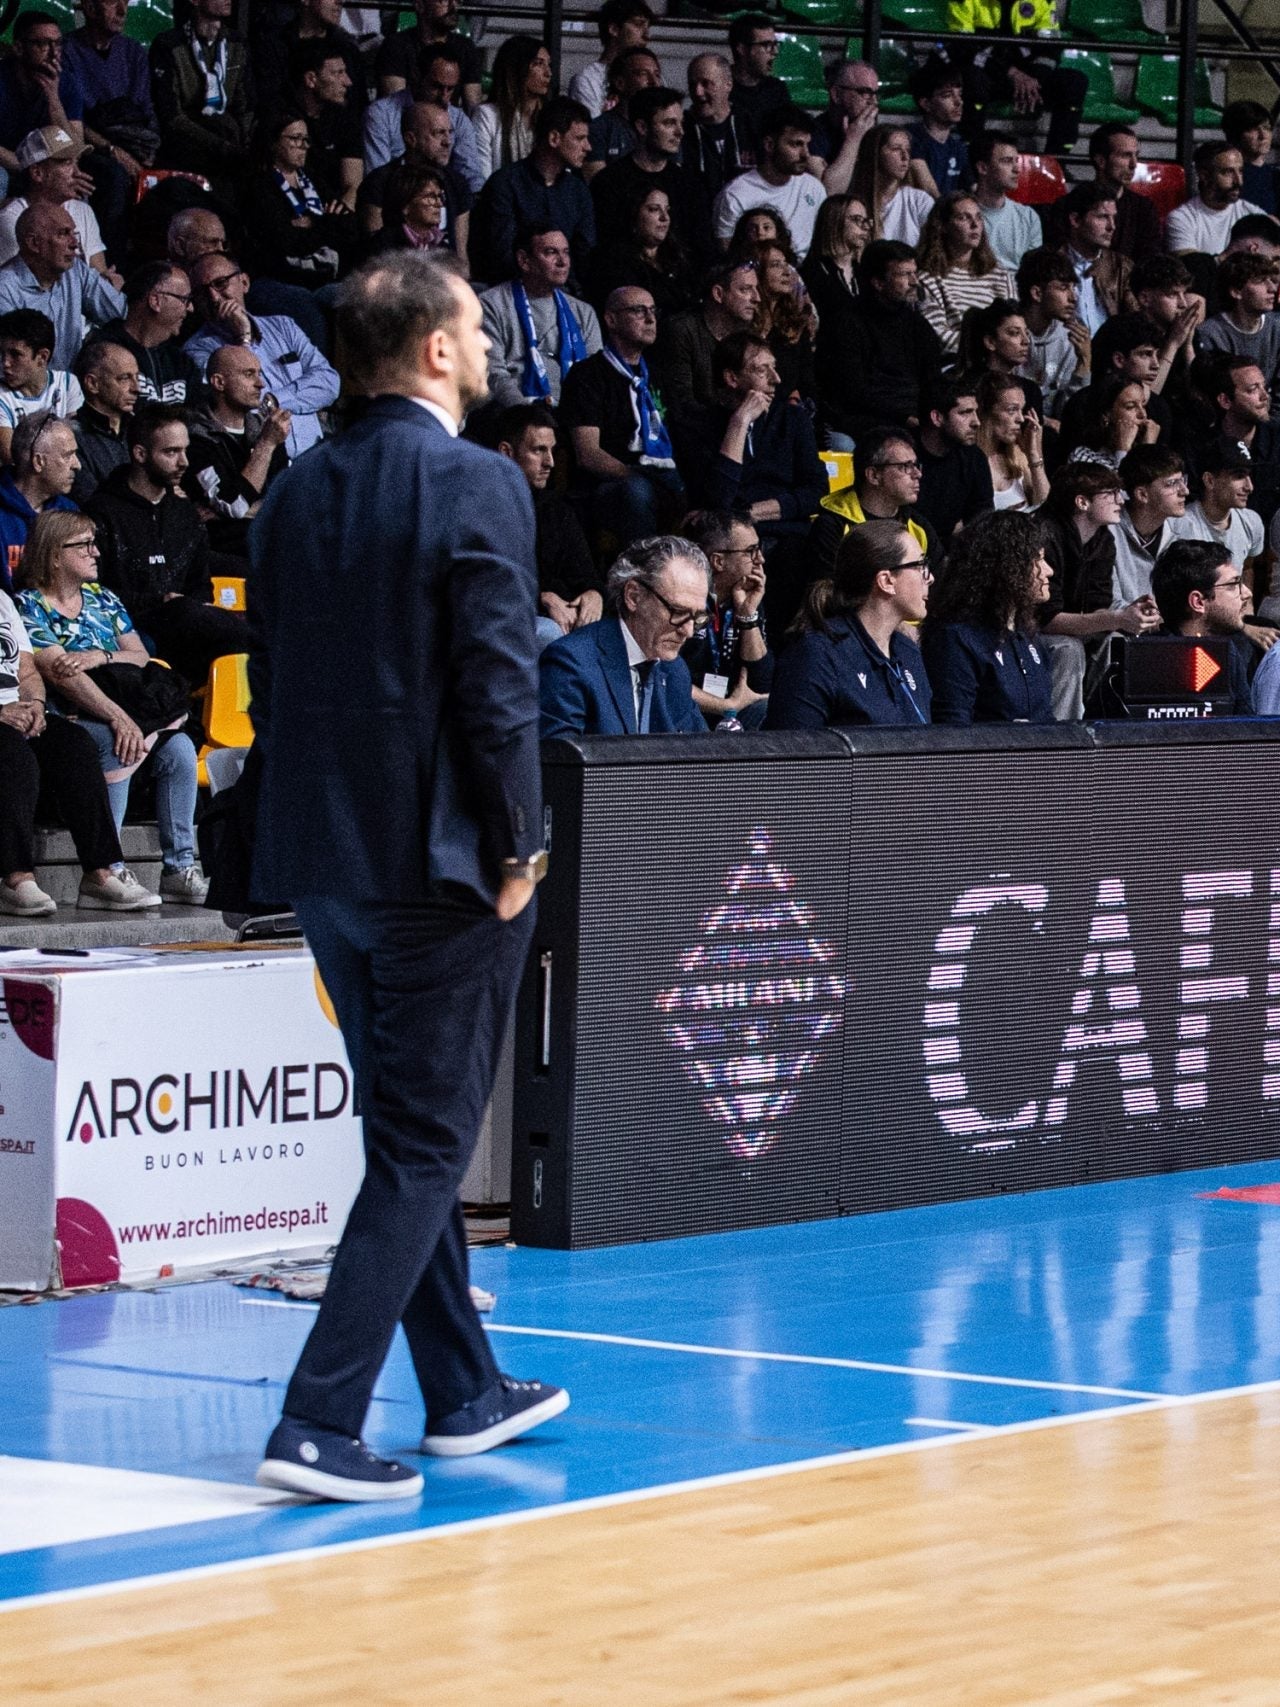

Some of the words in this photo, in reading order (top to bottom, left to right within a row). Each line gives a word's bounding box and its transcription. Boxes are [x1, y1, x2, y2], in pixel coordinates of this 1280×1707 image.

[66, 1061, 362, 1144] ARCHIMED
[145, 1152, 204, 1171] BUON
[219, 1142, 305, 1164] LAVORO
[118, 1201, 329, 1244] www.archimedespa.it
